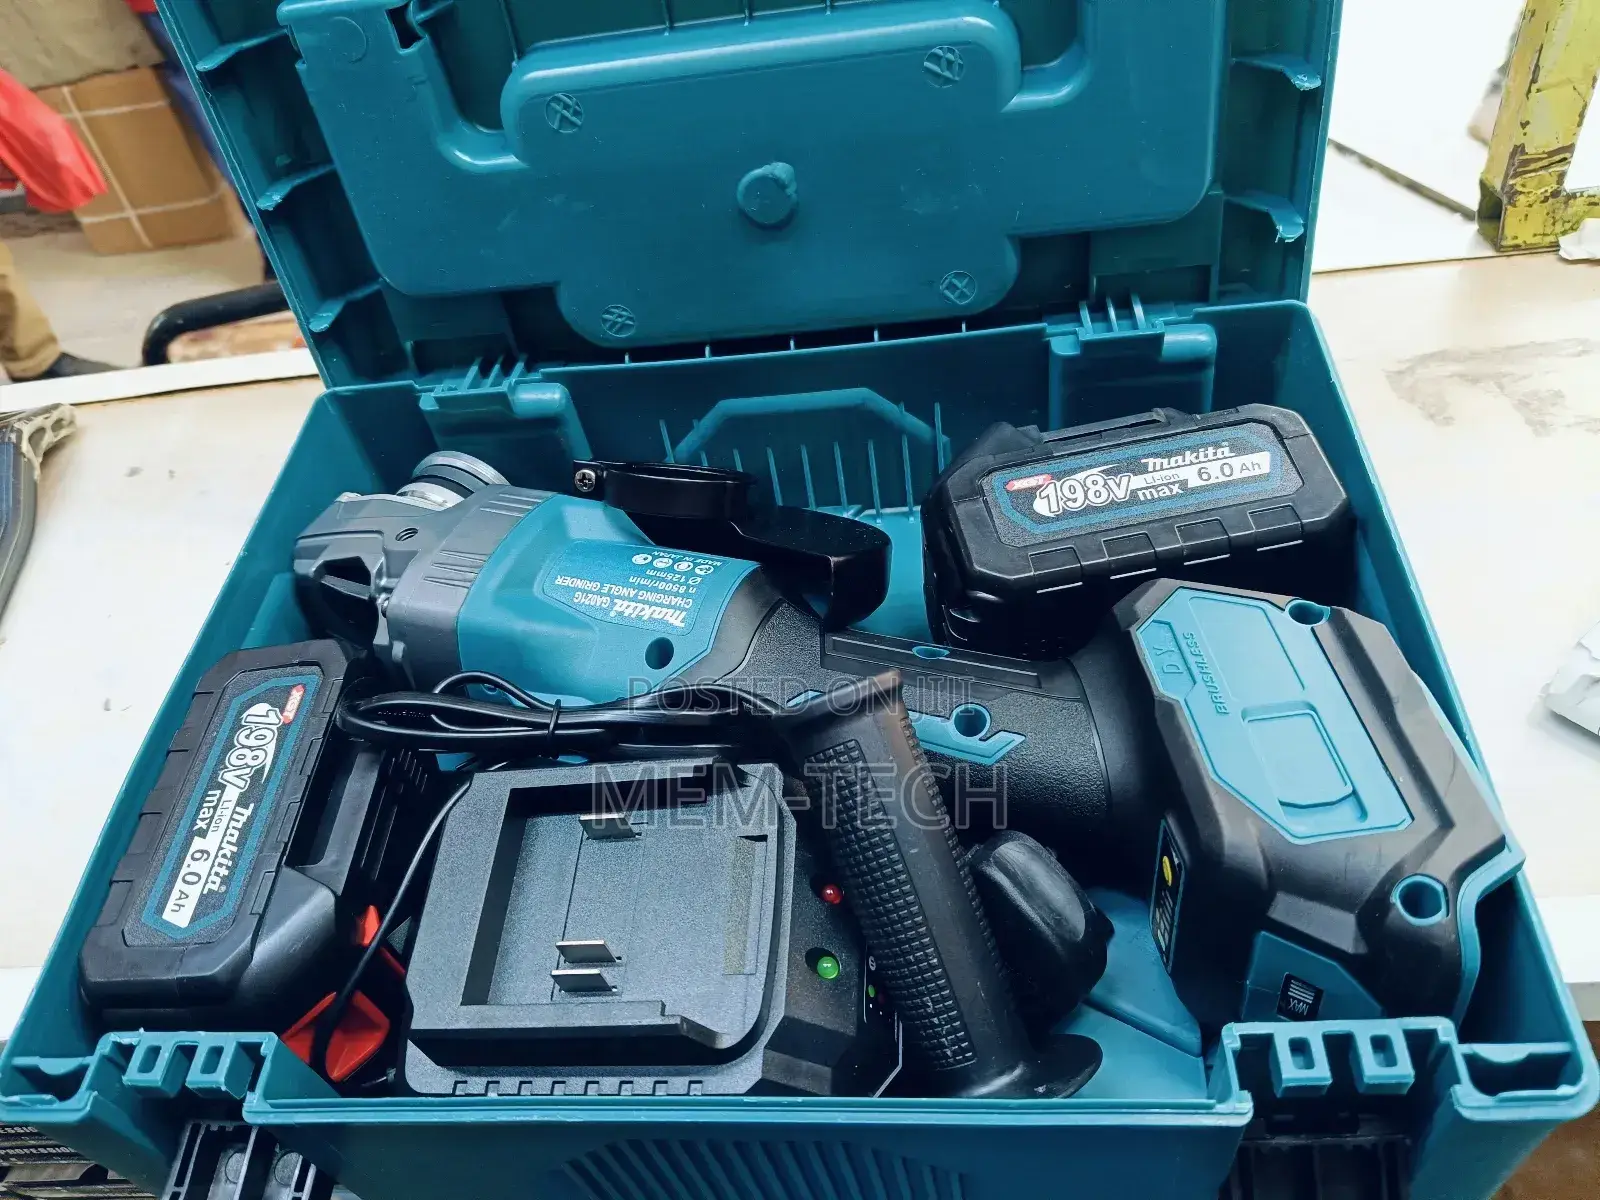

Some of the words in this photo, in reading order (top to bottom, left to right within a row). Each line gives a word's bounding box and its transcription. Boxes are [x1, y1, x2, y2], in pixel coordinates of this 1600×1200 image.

[1197, 462, 1234, 482] 6.0
[1239, 460, 1262, 475] Ah
[1137, 482, 1185, 501] max
[652, 551, 684, 560] JAPAN
[694, 558, 723, 567] MADE
[555, 574, 600, 593] GRINDER
[629, 575, 687, 594] 8500r/min
[646, 569, 686, 583] 125mm
[574, 591, 611, 609] GA021G
[601, 583, 637, 599] ANGLE
[638, 589, 693, 609] CHARGING
[1182, 631, 1230, 715] BRUSHLESS
[193, 789, 221, 831] max
[181, 849, 211, 886] 6.0
[170, 889, 190, 914] Ah
